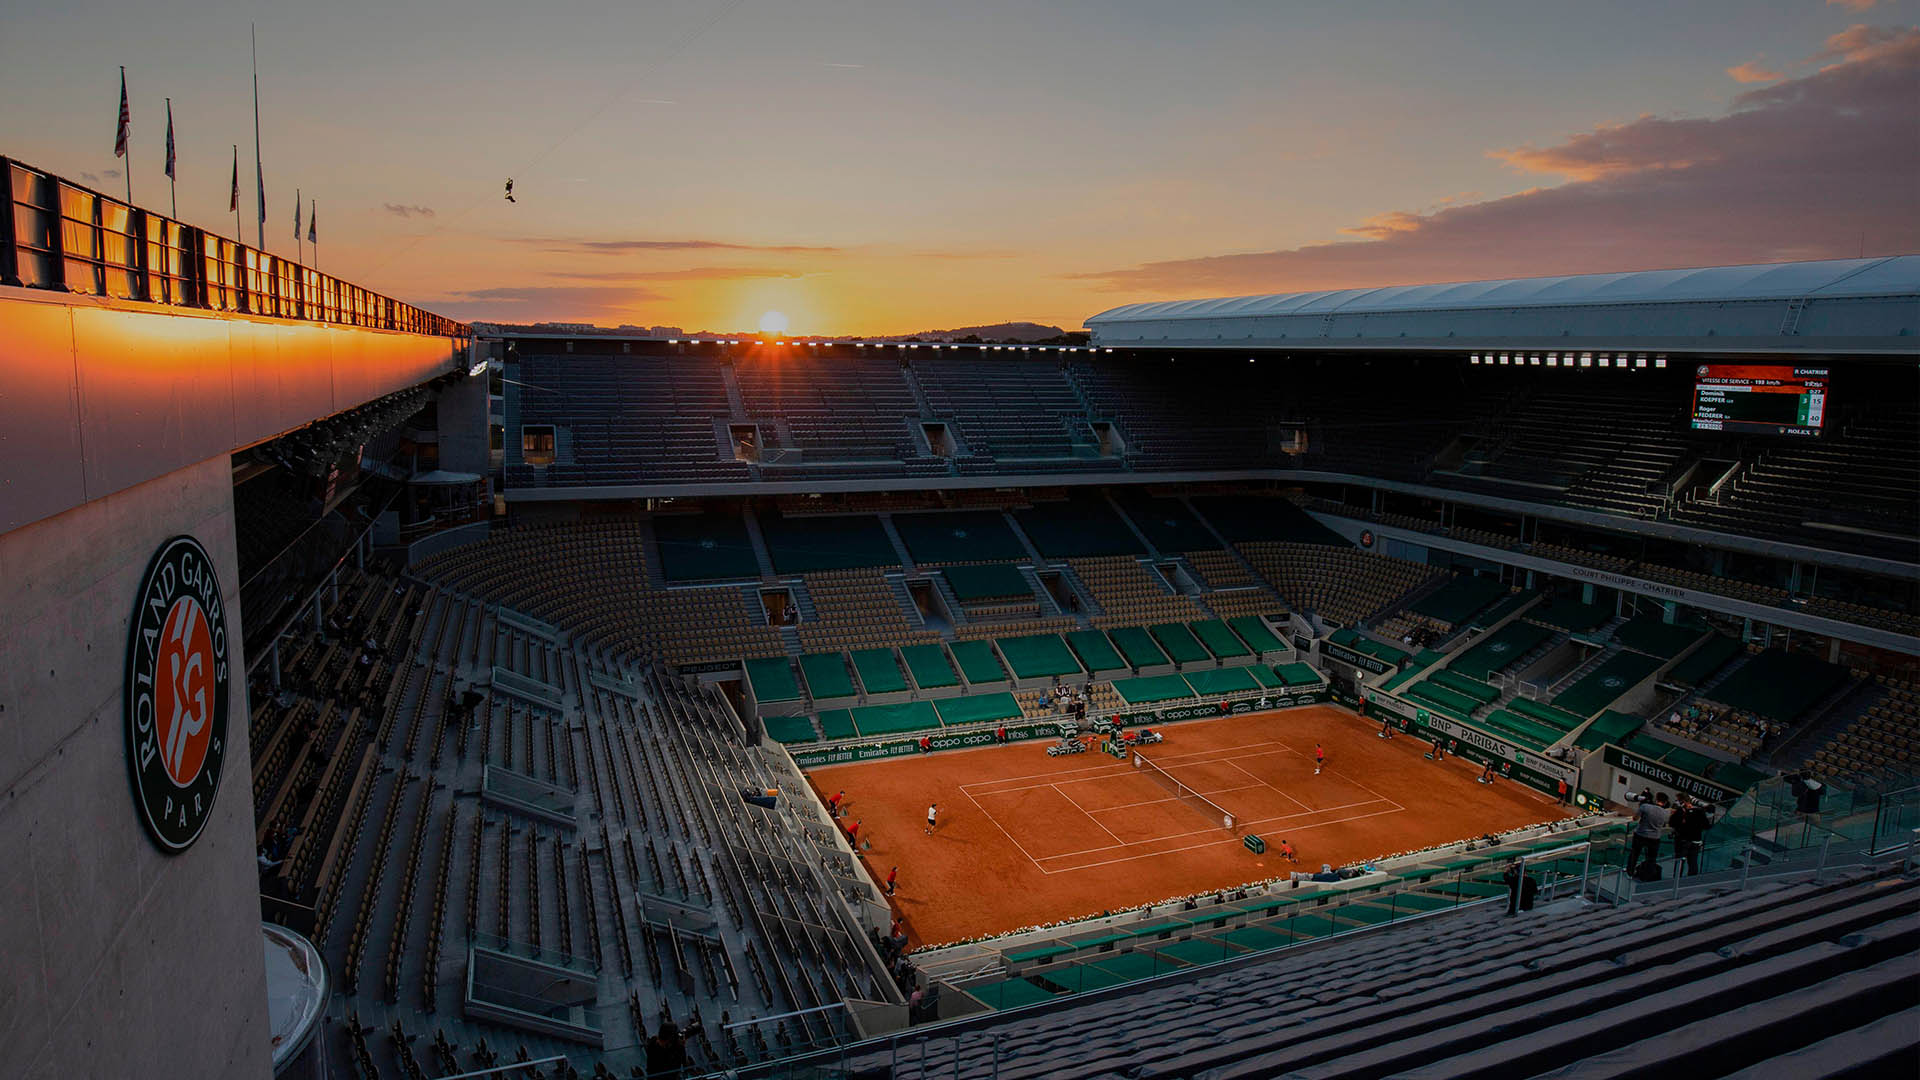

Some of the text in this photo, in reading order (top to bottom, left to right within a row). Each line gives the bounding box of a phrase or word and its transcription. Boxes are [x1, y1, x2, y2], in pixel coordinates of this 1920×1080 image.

[1572, 567, 1599, 578] COURT
[1600, 575, 1635, 586] PHILIPPE
[1642, 583, 1685, 597] CHATRIER
[137, 552, 227, 773] ROLAND GARROS
[1328, 645, 1357, 663] Emirates
[932, 737, 961, 748] oppo
[963, 734, 992, 745] oppo
[1431, 717, 1452, 732] BNP
[1461, 728, 1506, 756] PARIBAS
[859, 748, 889, 758] Emirates
[164, 736, 221, 828] PARIS
[1621, 754, 1724, 801] Emirates FLY BETTER
